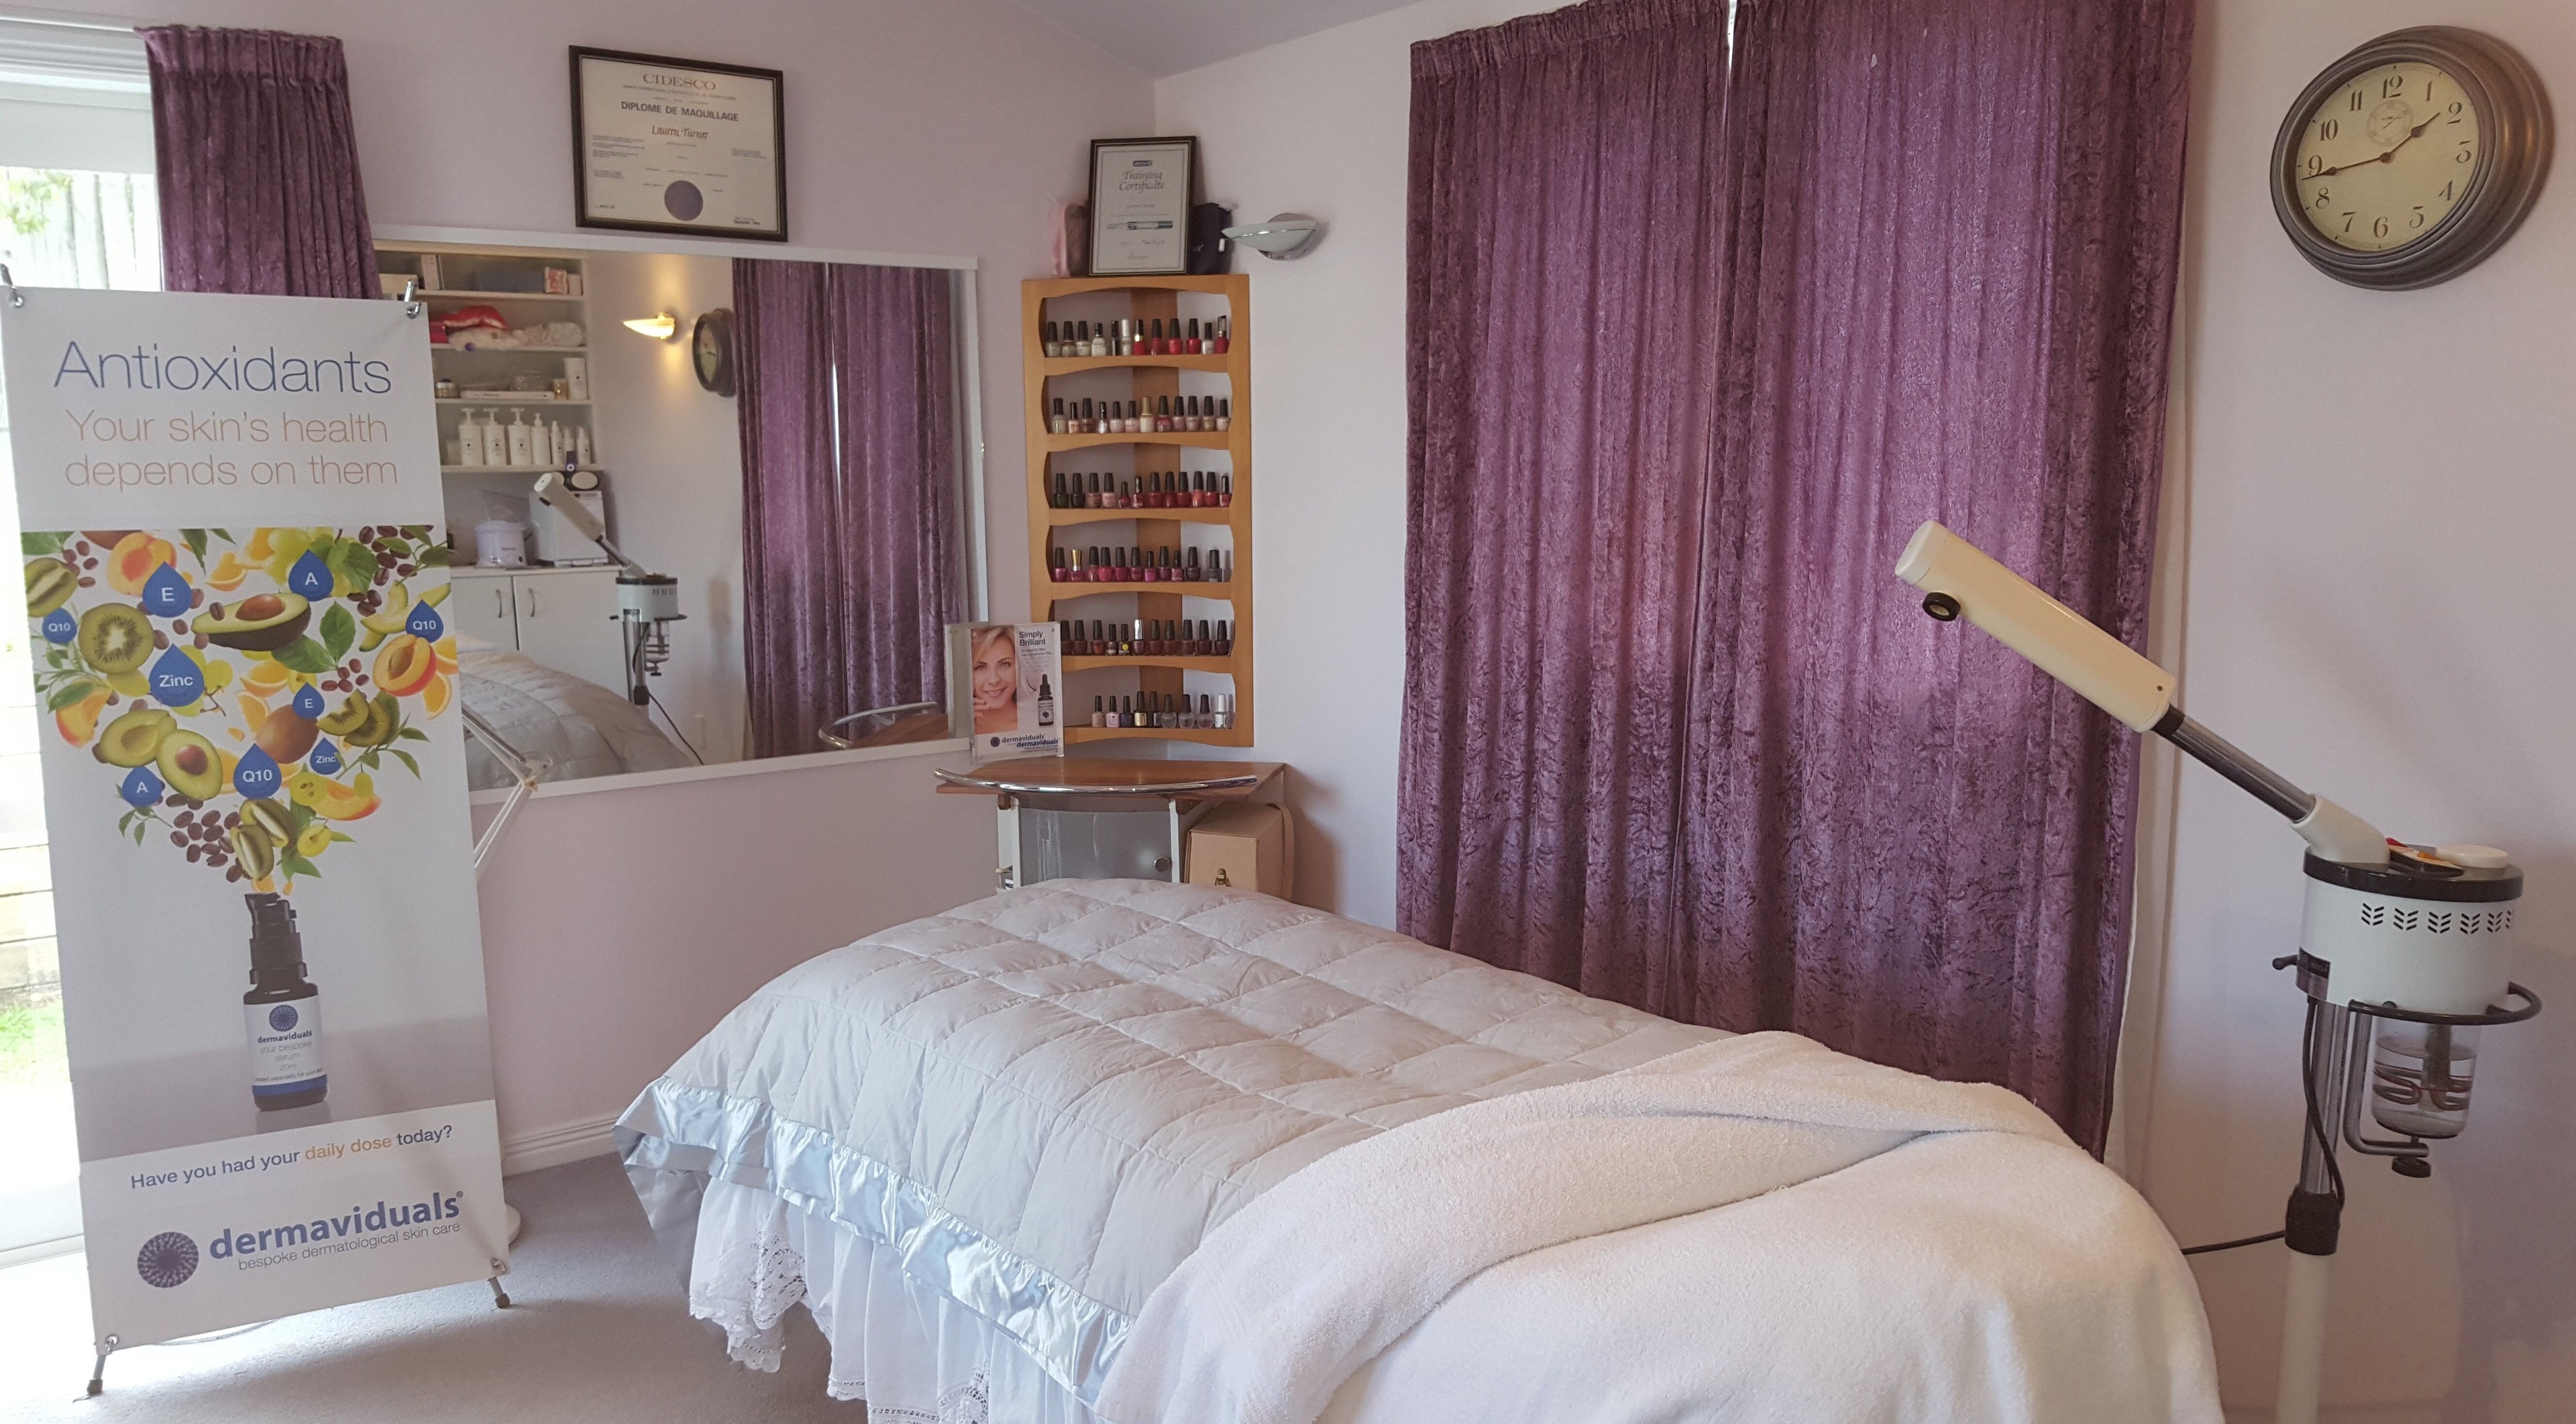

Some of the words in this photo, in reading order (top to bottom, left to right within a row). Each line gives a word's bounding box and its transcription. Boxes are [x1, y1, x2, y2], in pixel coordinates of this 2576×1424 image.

[643, 73, 716, 91] CIDESCO
[2382, 75, 2403, 99] 12
[2426, 80, 2432, 101] 1
[2349, 89, 2364, 111] 11
[621, 101, 661, 113] DIPLOME
[665, 106, 678, 115] DE
[682, 108, 739, 121] MAQUILLAGE
[2447, 101, 2463, 124] 2
[2320, 119, 2339, 141] 10
[2456, 140, 2471, 163] 3
[2308, 155, 2323, 176] 9
[1119, 179, 1165, 194] Certificate
[1122, 171, 1163, 182] Training
[2316, 188, 2330, 208] 8
[2438, 180, 2453, 201] 4
[2342, 212, 2357, 232] 7
[2373, 217, 2388, 237] 6
[2410, 206, 2424, 228] 5
[54, 341, 392, 394] Antioxidants
[65, 410, 154, 442] Your
[169, 410, 269, 443] skin's
[283, 412, 388, 443] health
[66, 455, 237, 492] depends
[252, 461, 296, 485] on
[308, 456, 398, 485] them
[305, 572, 318, 586] A
[162, 588, 174, 602] E
[48, 620, 70, 634] Q10
[413, 618, 437, 633] Q10
[1020, 630, 1043, 640] Simply
[159, 673, 193, 688] Zinc
[305, 698, 313, 708] E
[315, 754, 336, 765] Zinc
[242, 769, 272, 784] Q10
[136, 781, 148, 793] A
[258, 1030, 313, 1043] dermaviduals
[131, 1169, 178, 1189] Have
[183, 1165, 217, 1184] you
[222, 1156, 256, 1174] had
[261, 1150, 301, 1171] your
[305, 1142, 345, 1160] daily
[350, 1136, 392, 1154] dose
[396, 1125, 453, 1146] today?
[238, 1250, 298, 1271] bespoke
[302, 1231, 399, 1260] dermatological
[403, 1225, 429, 1241] skin
[433, 1221, 461, 1236] care
